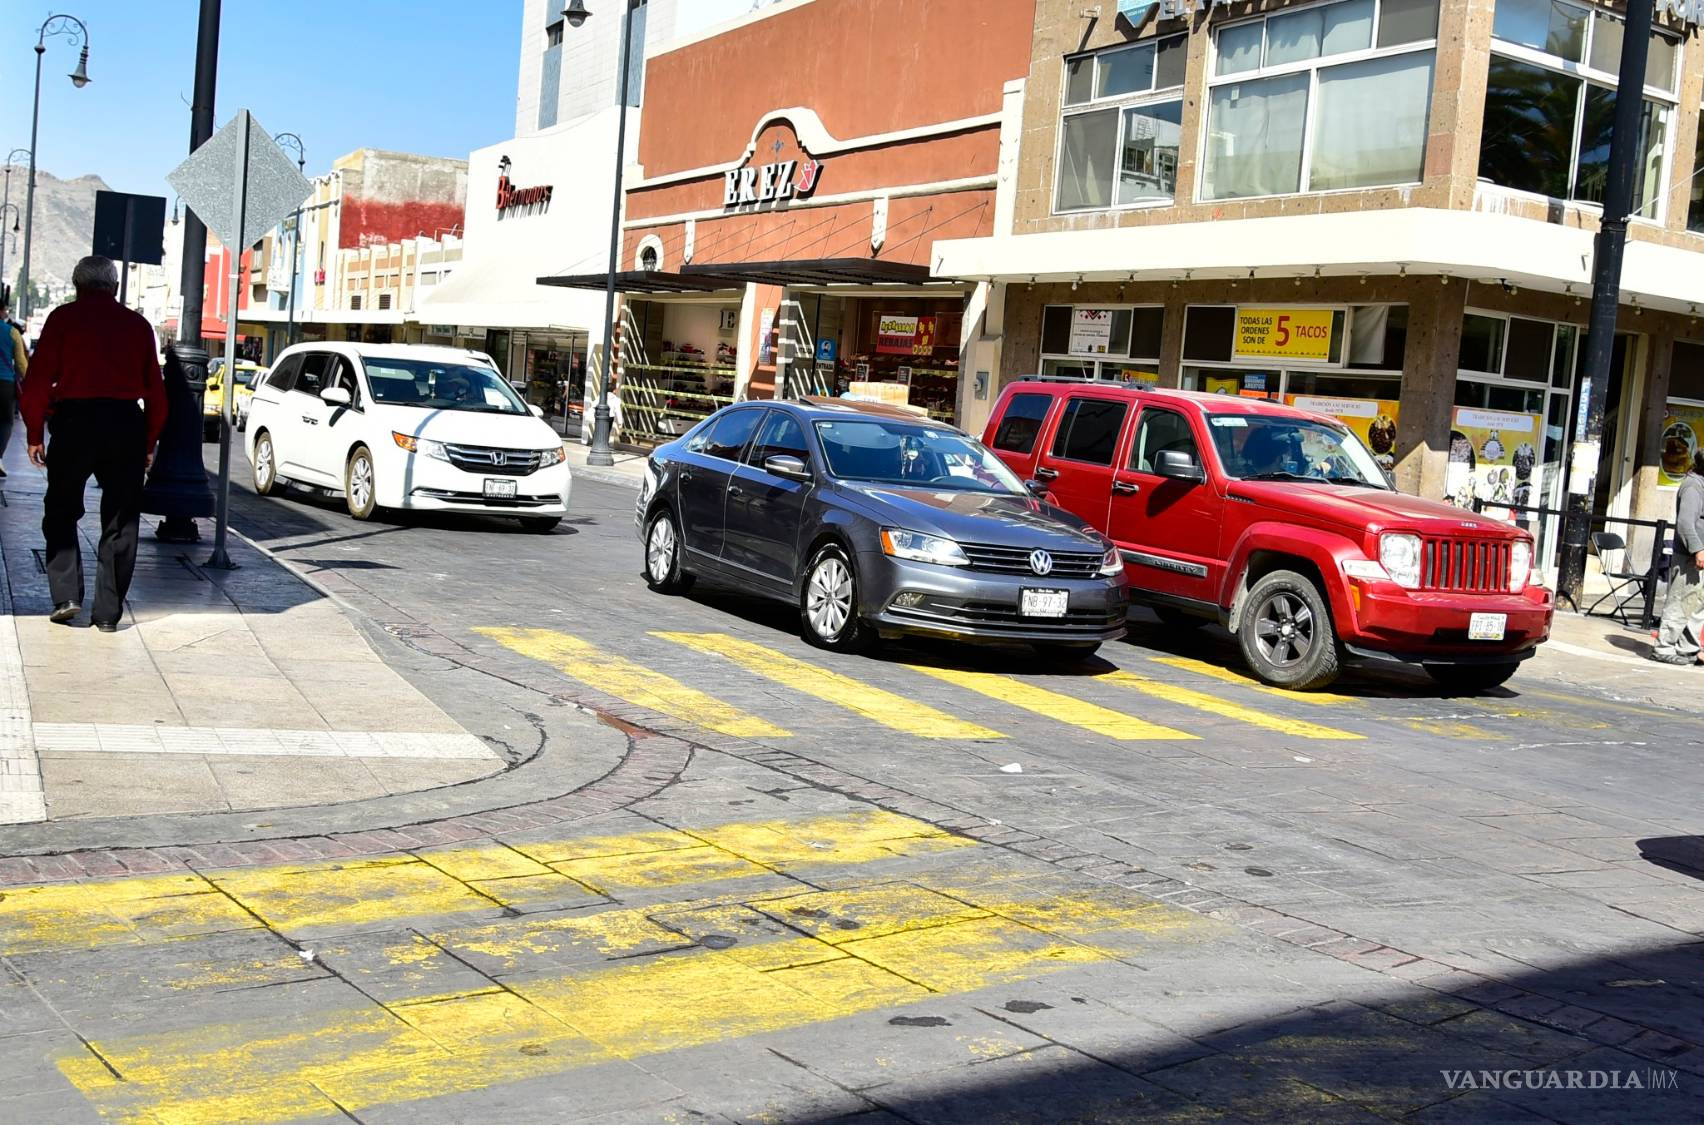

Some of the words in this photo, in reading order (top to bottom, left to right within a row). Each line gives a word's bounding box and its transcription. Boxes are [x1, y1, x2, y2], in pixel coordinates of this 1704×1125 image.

[722, 160, 796, 206] EREZ
[1240, 316, 1260, 325] TODAS
[1261, 317, 1272, 326] LAS
[1240, 326, 1270, 335] ORDENES
[1275, 315, 1290, 347] 5
[1296, 325, 1328, 338] TACOS
[1243, 336, 1256, 344] SON
[1257, 336, 1265, 345] DE
[1154, 560, 1198, 573] LIBERTY
